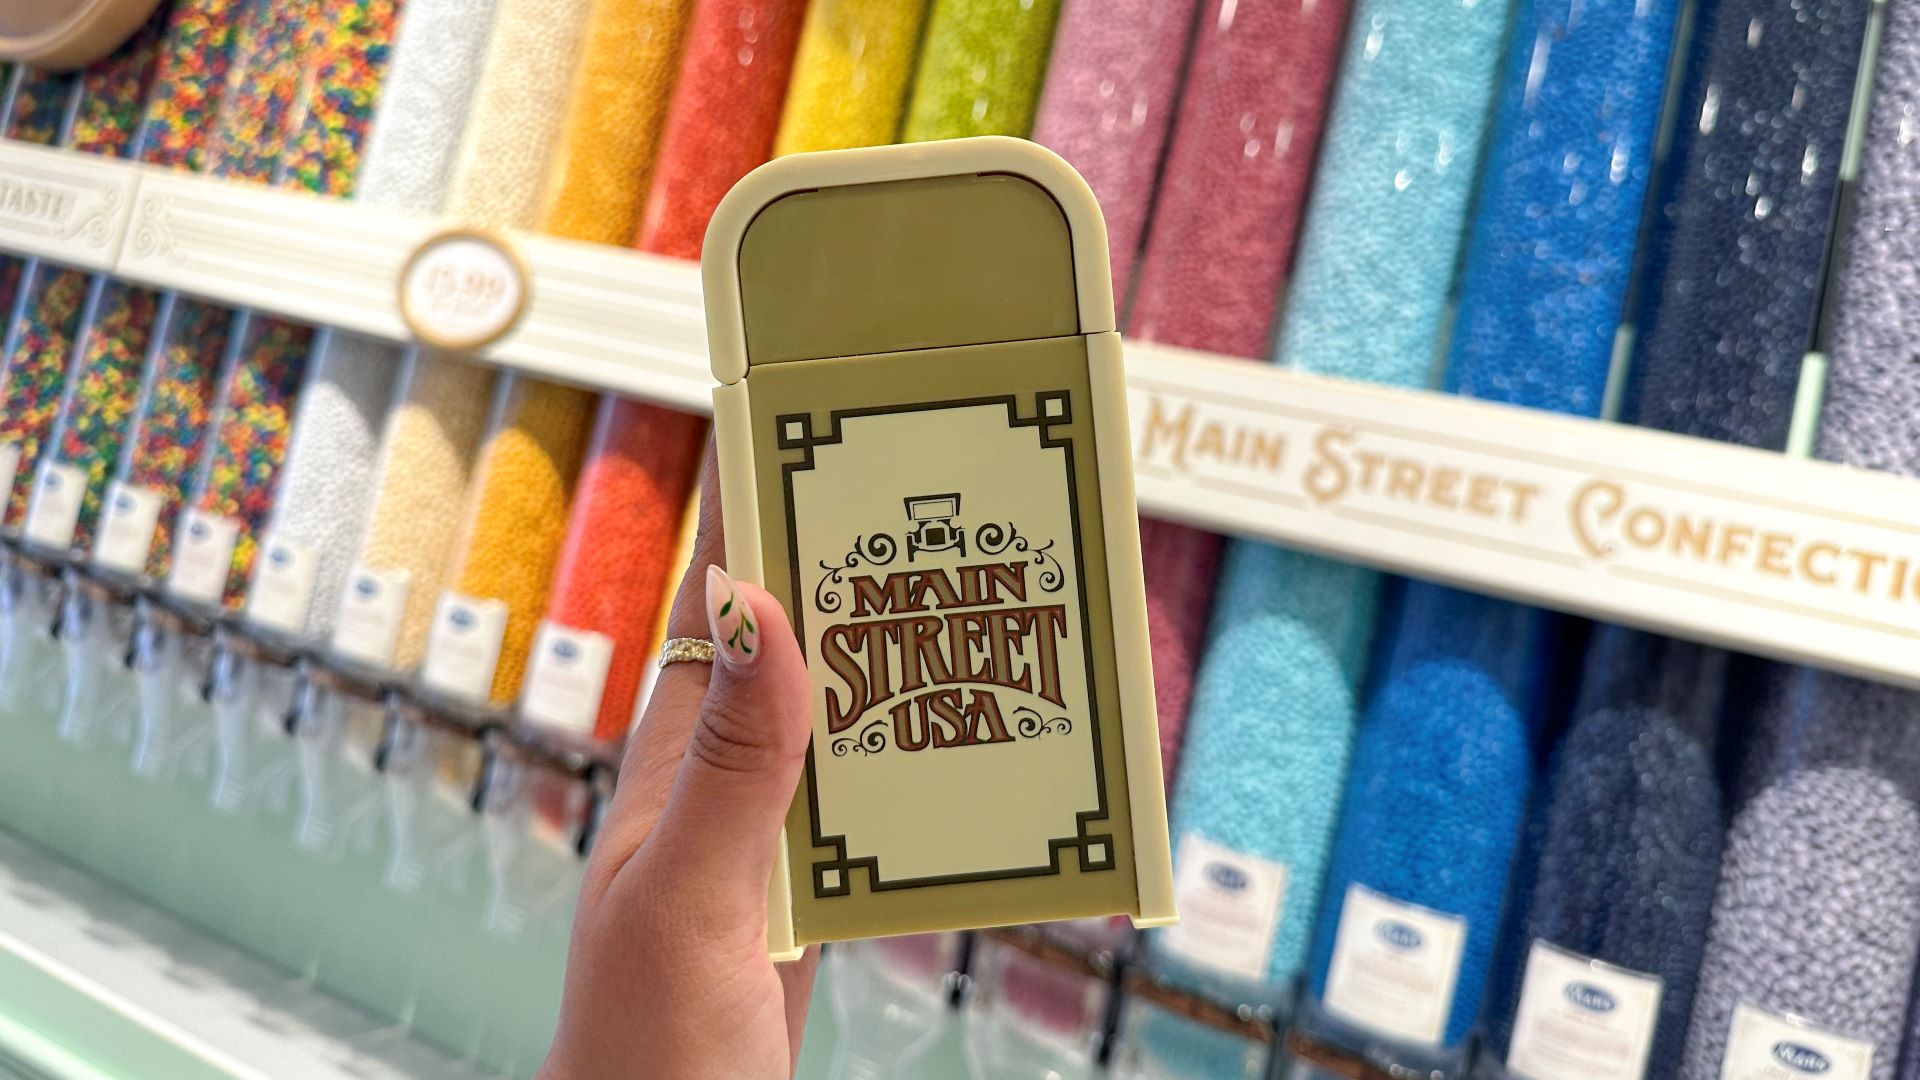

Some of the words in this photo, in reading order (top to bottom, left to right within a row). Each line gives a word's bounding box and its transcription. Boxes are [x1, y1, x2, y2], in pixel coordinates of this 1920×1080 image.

[1567, 476, 1920, 603] CONFECTI
[848, 561, 1029, 618] MAIN
[820, 604, 1068, 735] STREET
[889, 687, 1016, 751] USA
